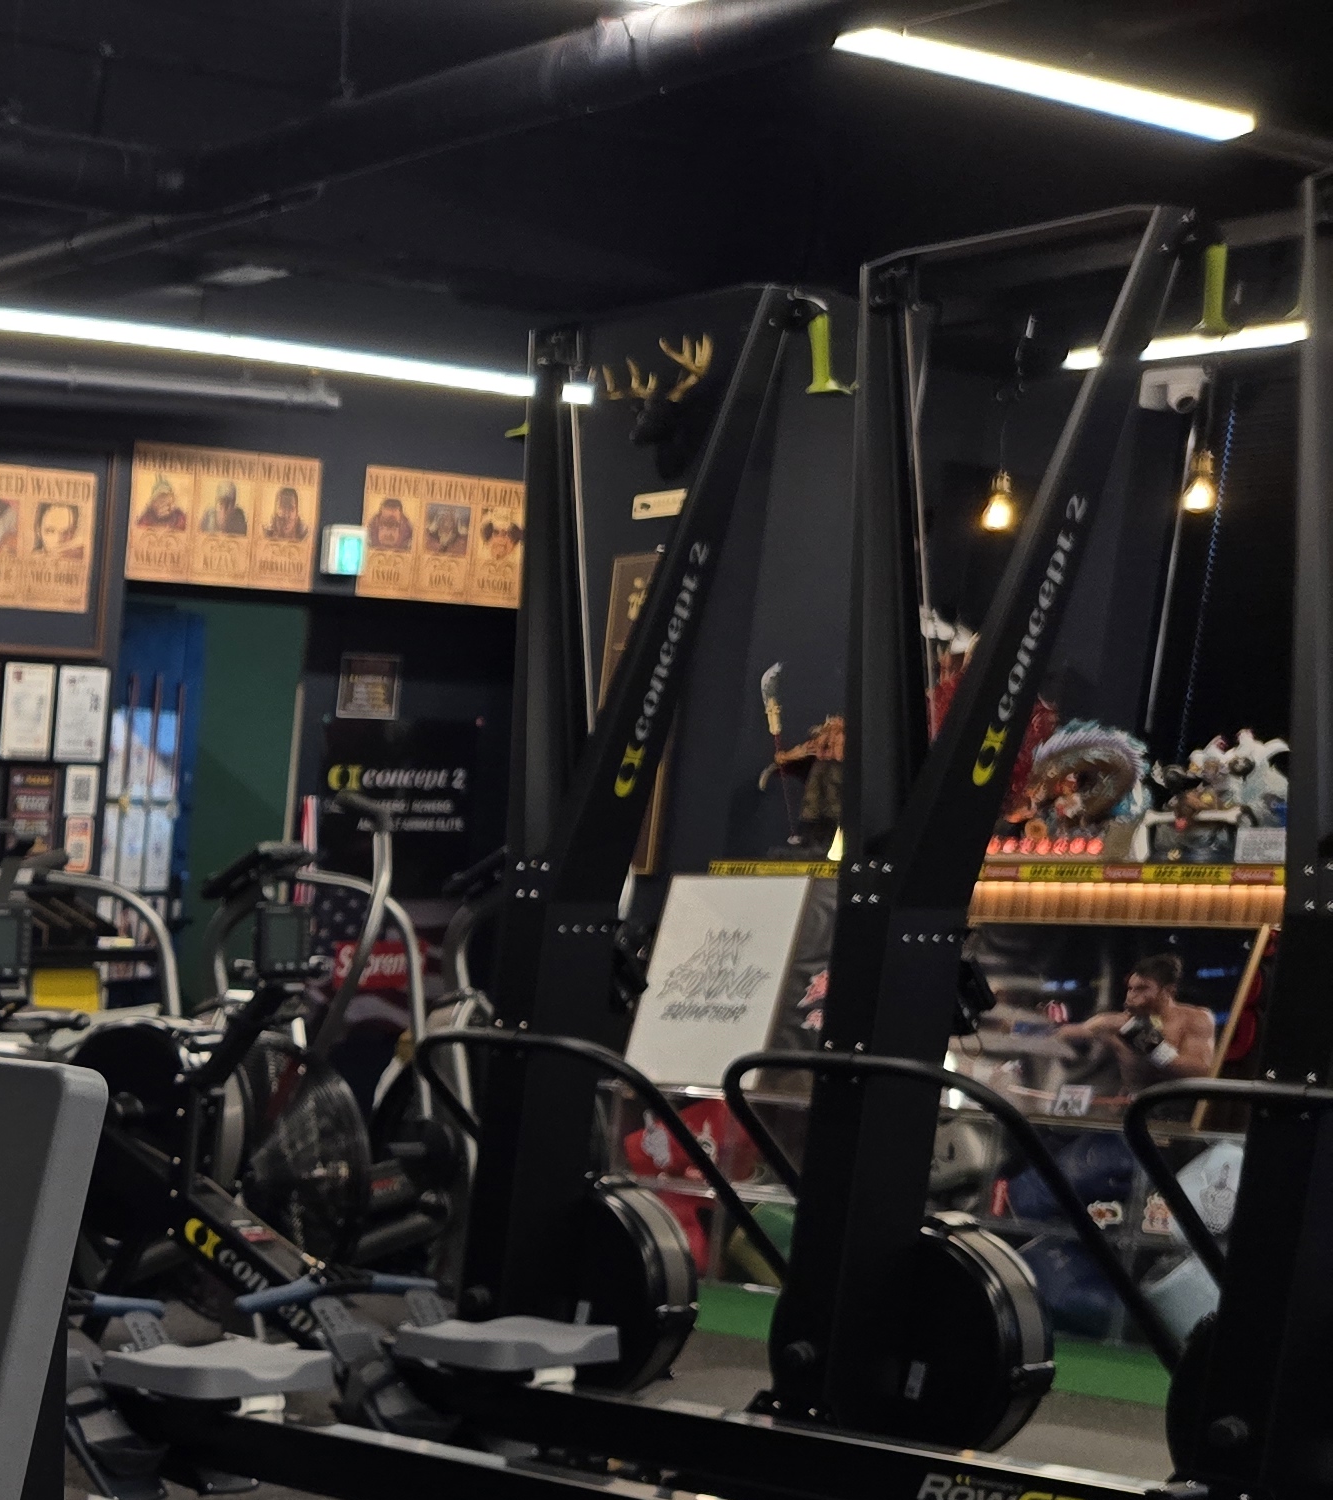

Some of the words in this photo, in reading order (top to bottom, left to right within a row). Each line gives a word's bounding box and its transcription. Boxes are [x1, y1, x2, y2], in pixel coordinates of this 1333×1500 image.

[135, 452, 194, 473] MARINE
[201, 458, 257, 479] MARINE
[261, 462, 315, 485] MARINE
[30, 475, 91, 501] WANTED
[367, 474, 421, 498] MARINE
[425, 479, 476, 504] MARINE
[481, 484, 522, 507] MARIN
[998, 530, 1074, 723] concept
[1066, 494, 1088, 522] 2
[635, 572, 699, 741] concept
[362, 767, 450, 791] concept
[451, 767, 468, 790] 2
[335, 944, 411, 986] Sprem
